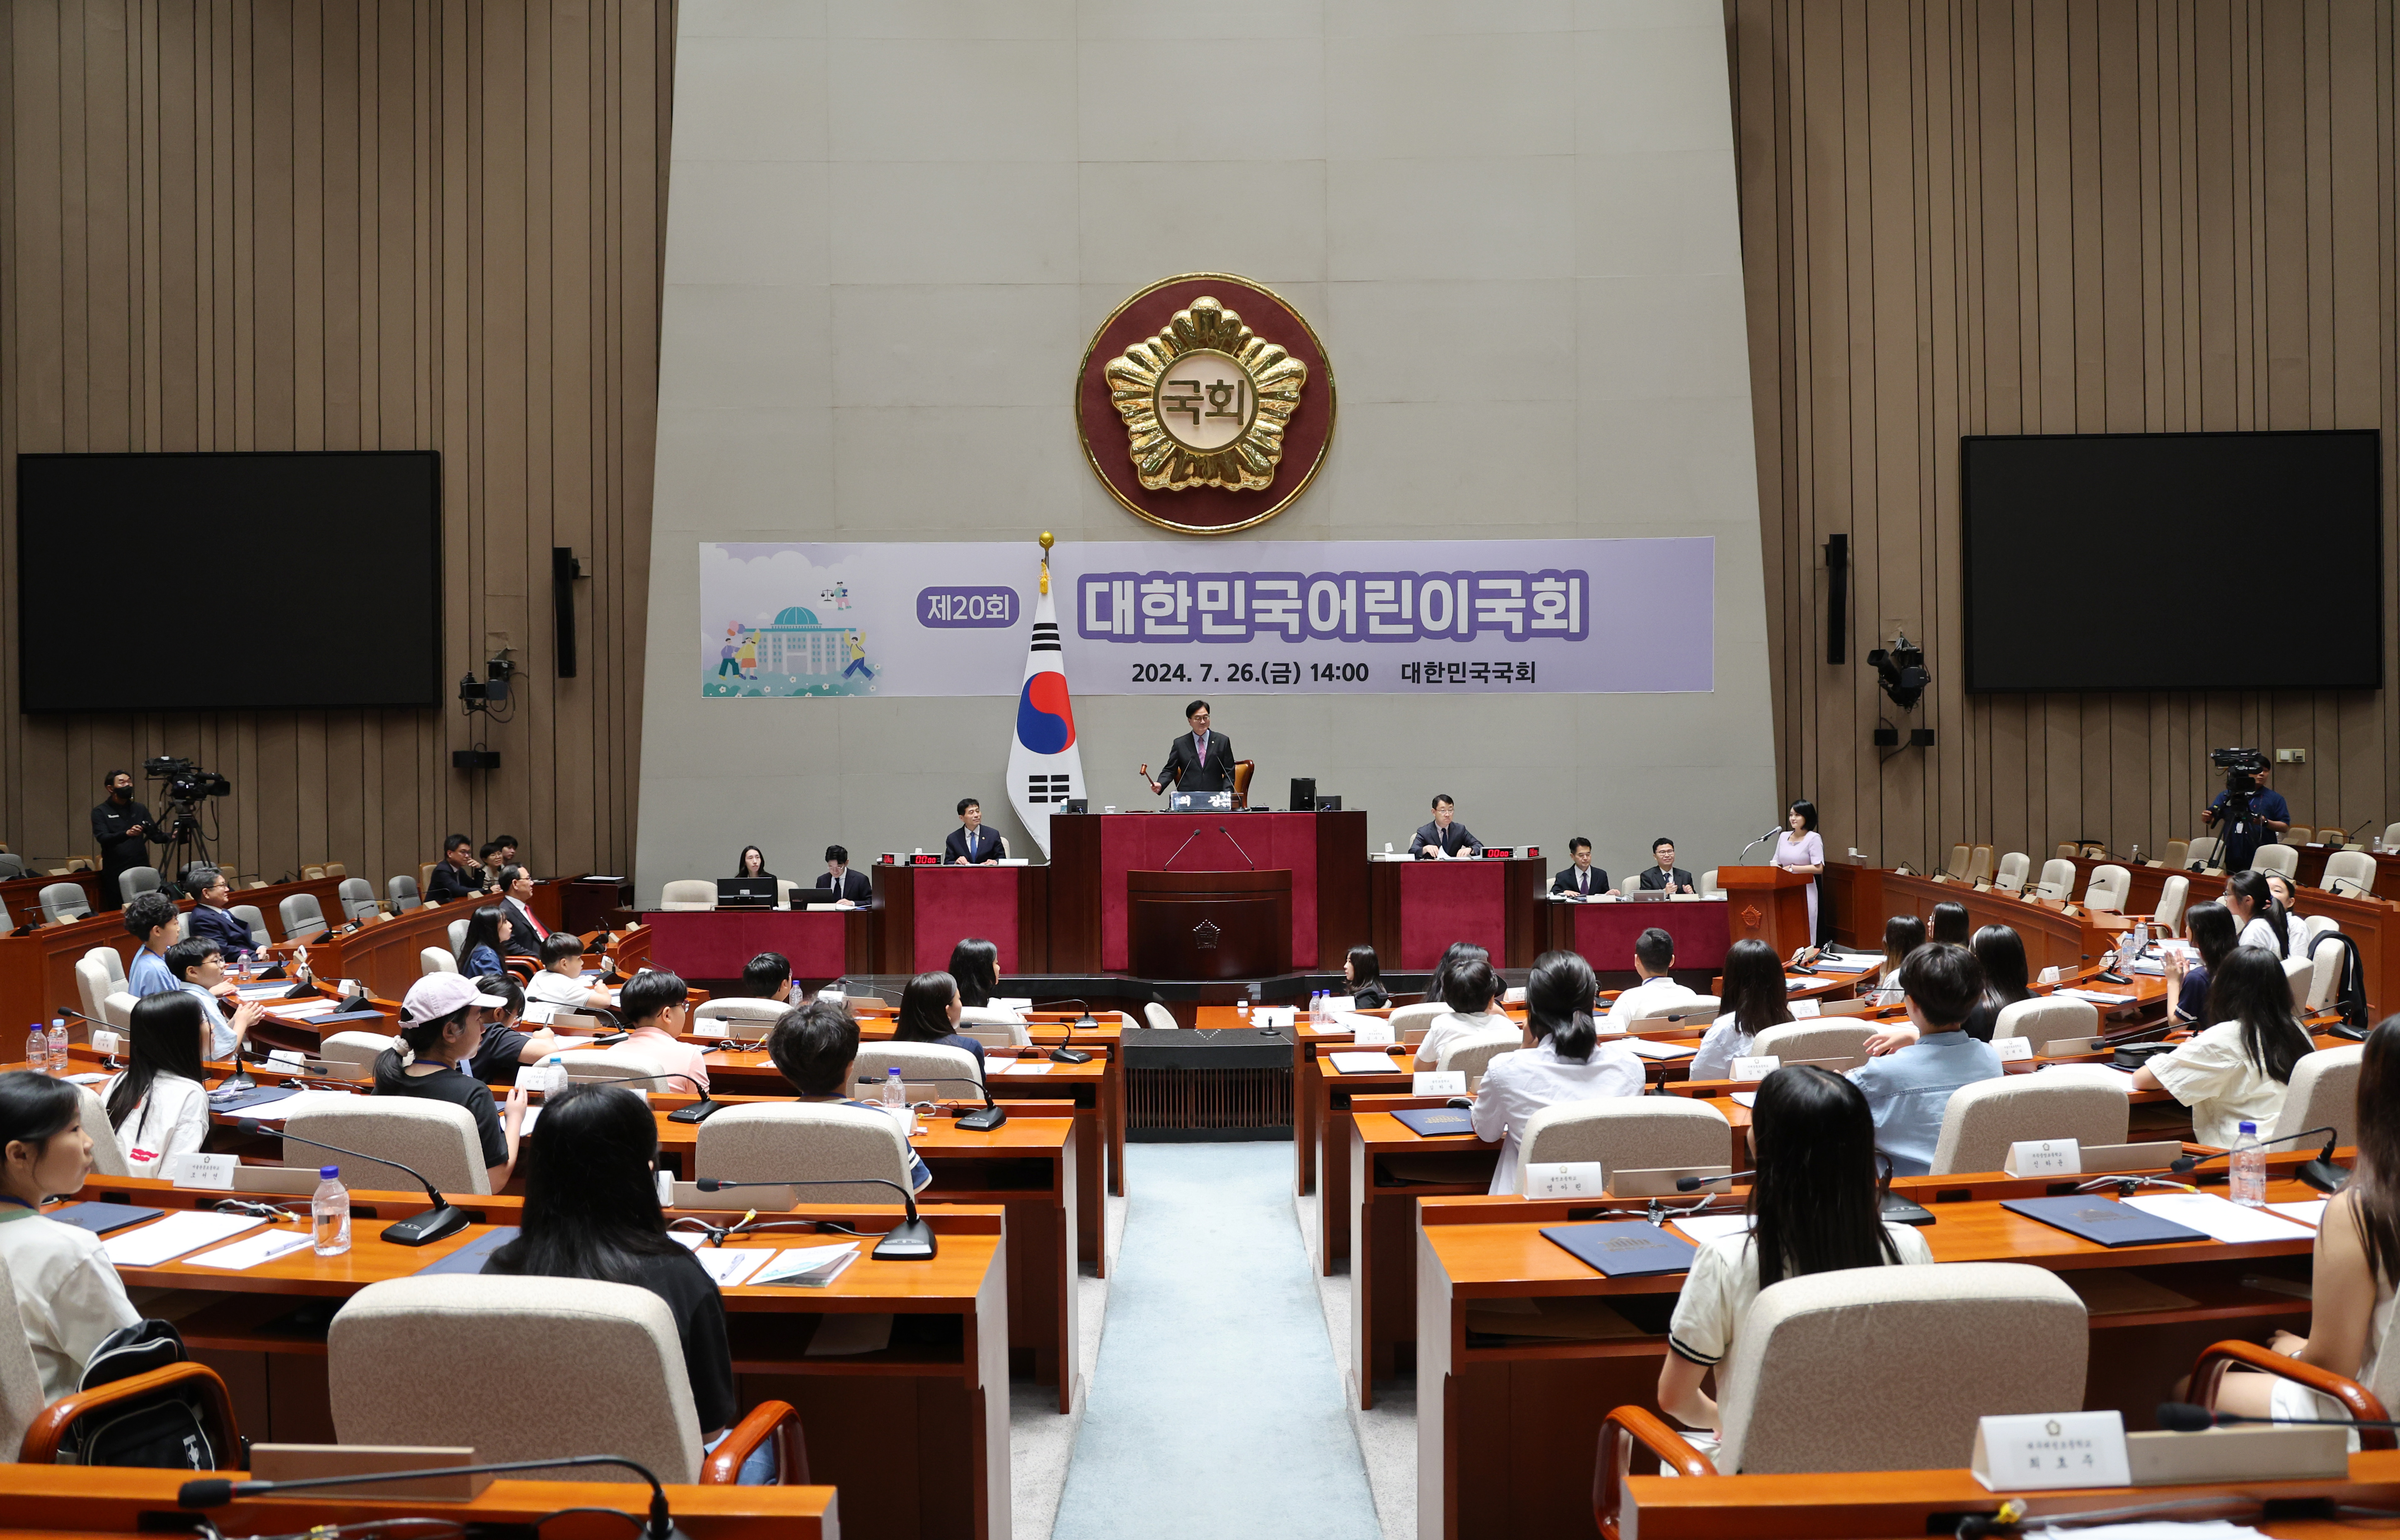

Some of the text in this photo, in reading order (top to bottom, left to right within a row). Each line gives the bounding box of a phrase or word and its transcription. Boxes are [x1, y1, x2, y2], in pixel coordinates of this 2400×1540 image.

[1161, 379, 1245, 426] 국회
[928, 594, 1009, 621] 제20회
[1086, 576, 1580, 635] 대한민국어린이국회
[1132, 661, 1369, 684] 2024. 7. 26.(금) 14:00
[1401, 661, 1536, 684] 대한민국국회
[2034, 1159, 2063, 1168] 신하윤
[190, 1172, 218, 1180] 조서연
[1547, 1183, 1581, 1192] 염아린
